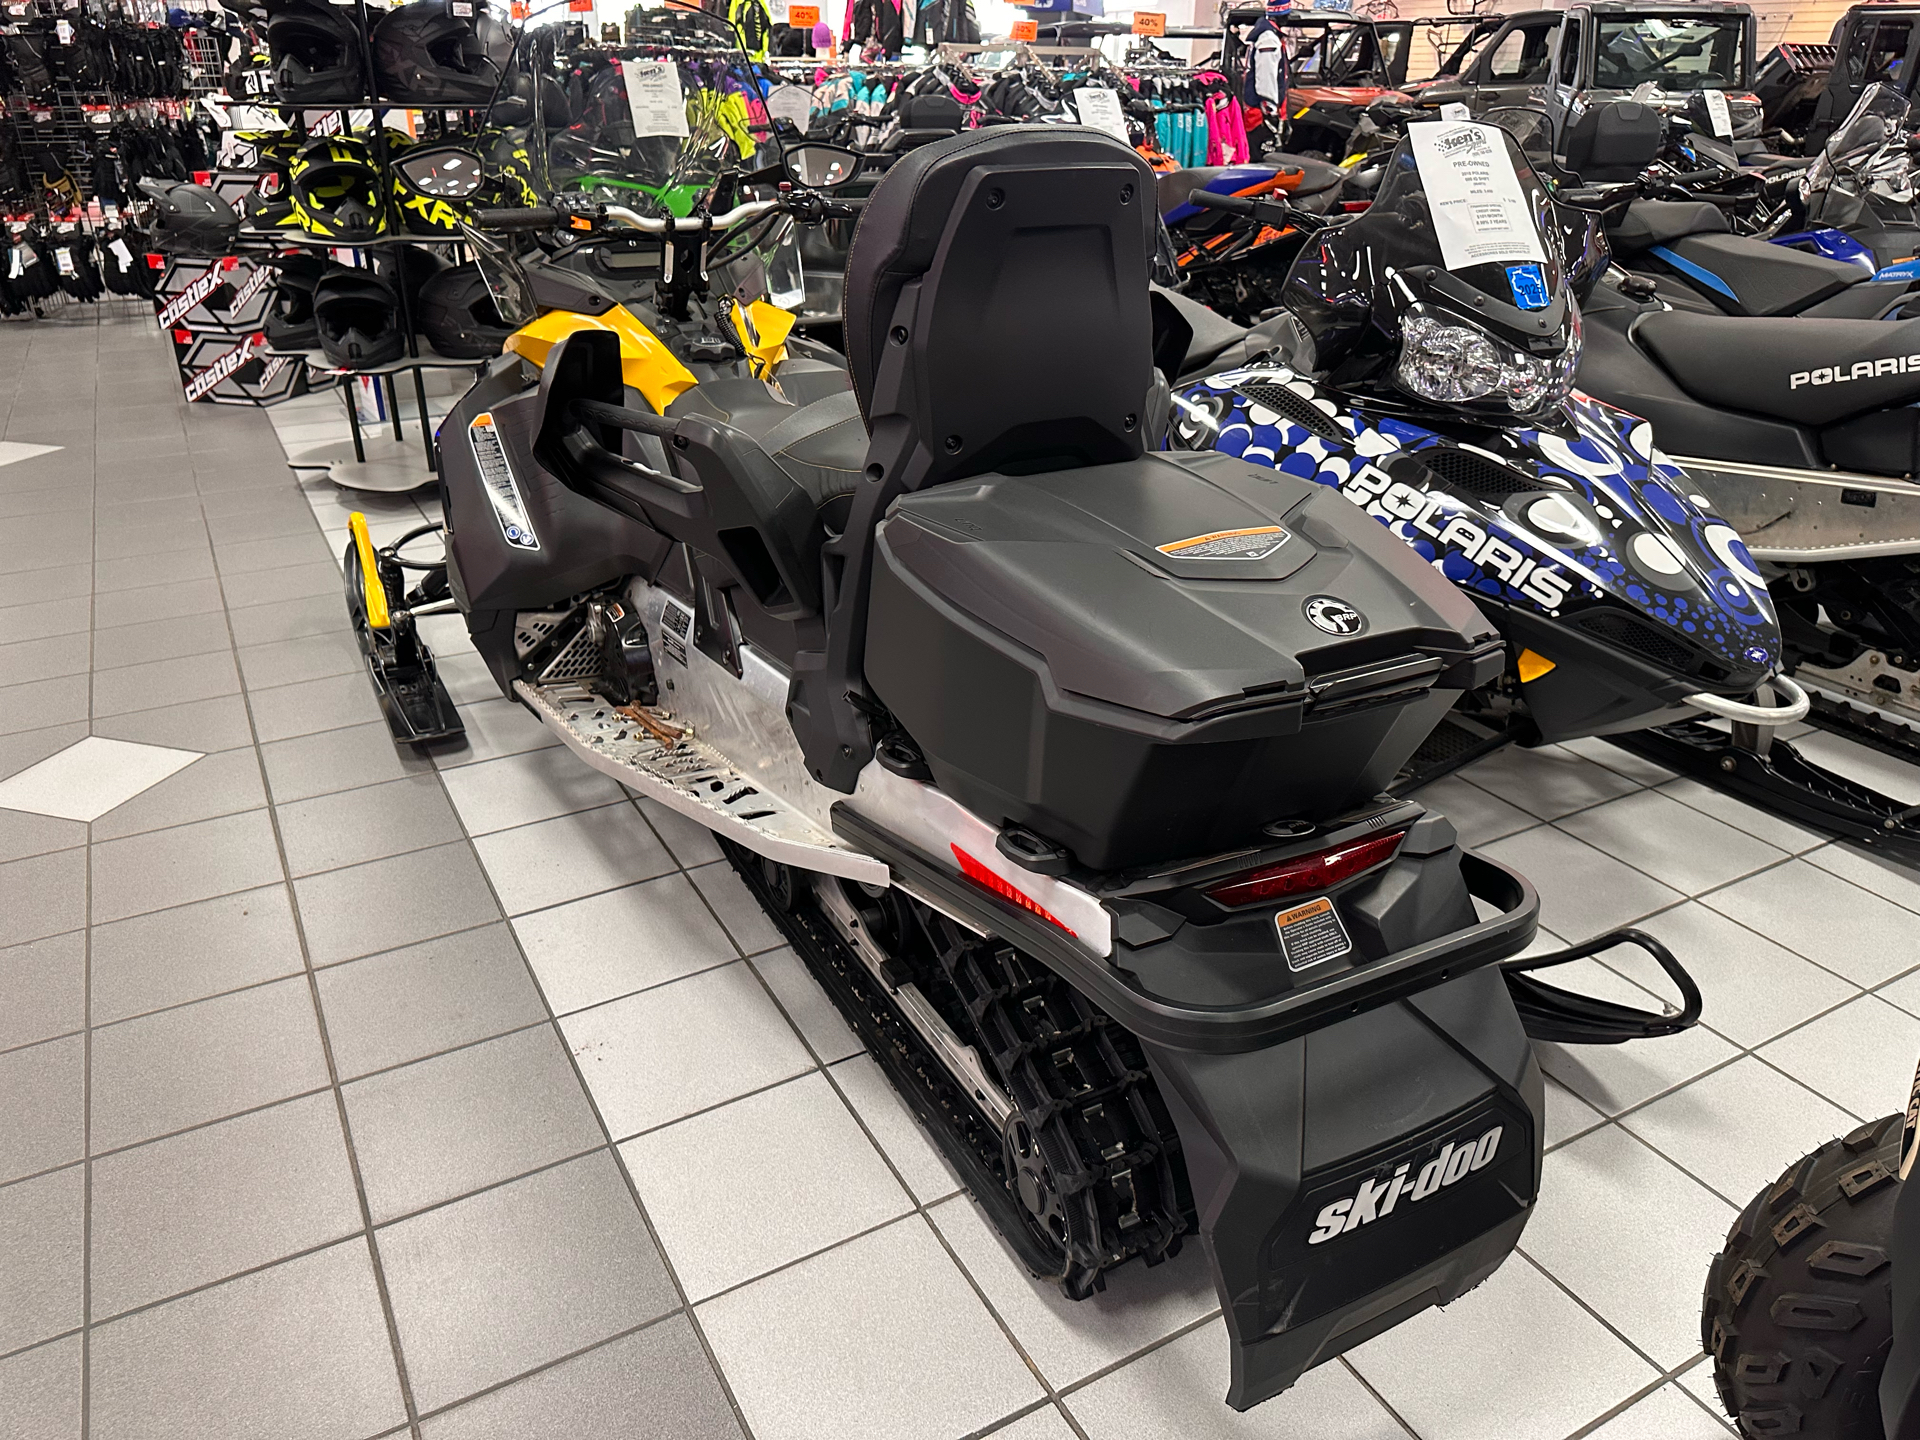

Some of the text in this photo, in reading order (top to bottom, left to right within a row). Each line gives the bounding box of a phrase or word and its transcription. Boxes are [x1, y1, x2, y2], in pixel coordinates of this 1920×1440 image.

[1139, 18, 1158, 27] 40%
[1790, 354, 1920, 390] POLARIS
[1347, 463, 1572, 608] POLARIS
[1333, 612, 1357, 622] BRP
[1292, 904, 1322, 920] WARNING
[1308, 1126, 1503, 1244] ski-doo
